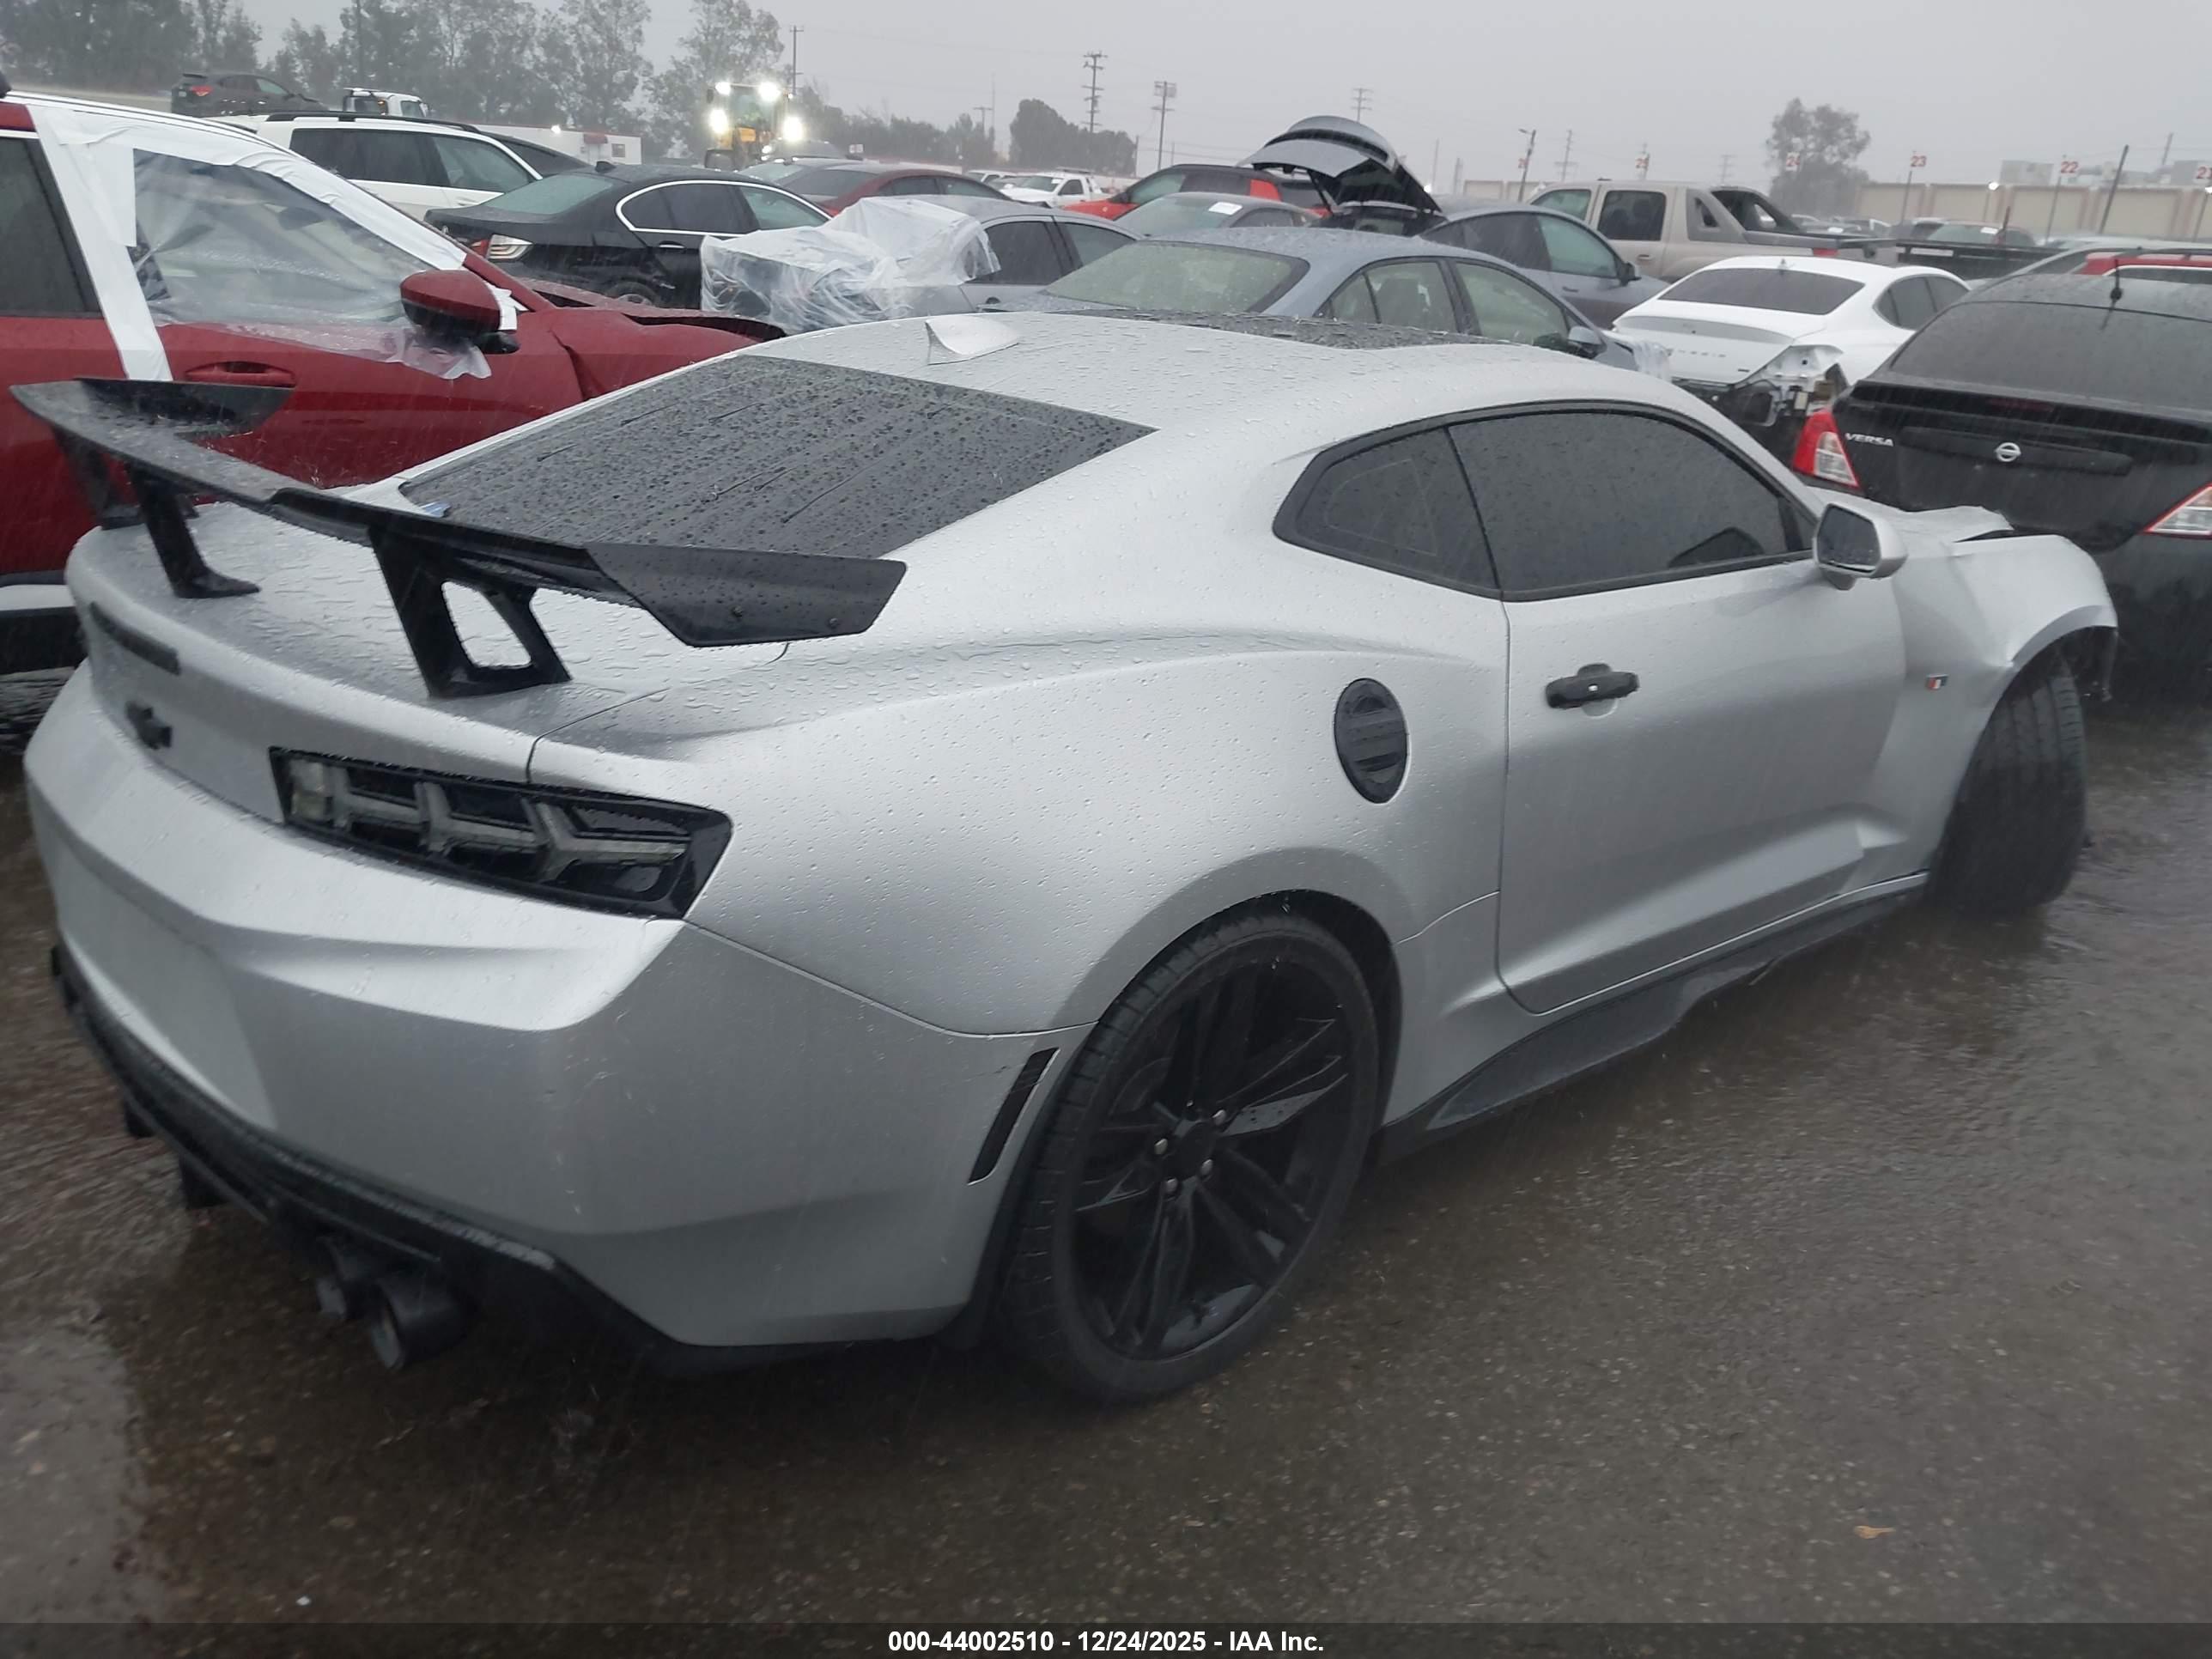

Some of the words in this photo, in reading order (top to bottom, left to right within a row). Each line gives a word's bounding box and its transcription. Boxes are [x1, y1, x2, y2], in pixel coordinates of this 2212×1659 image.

[1911, 155, 1927, 167] 23
[2060, 161, 2079, 173] 22
[1844, 432, 1894, 447] VERSA
